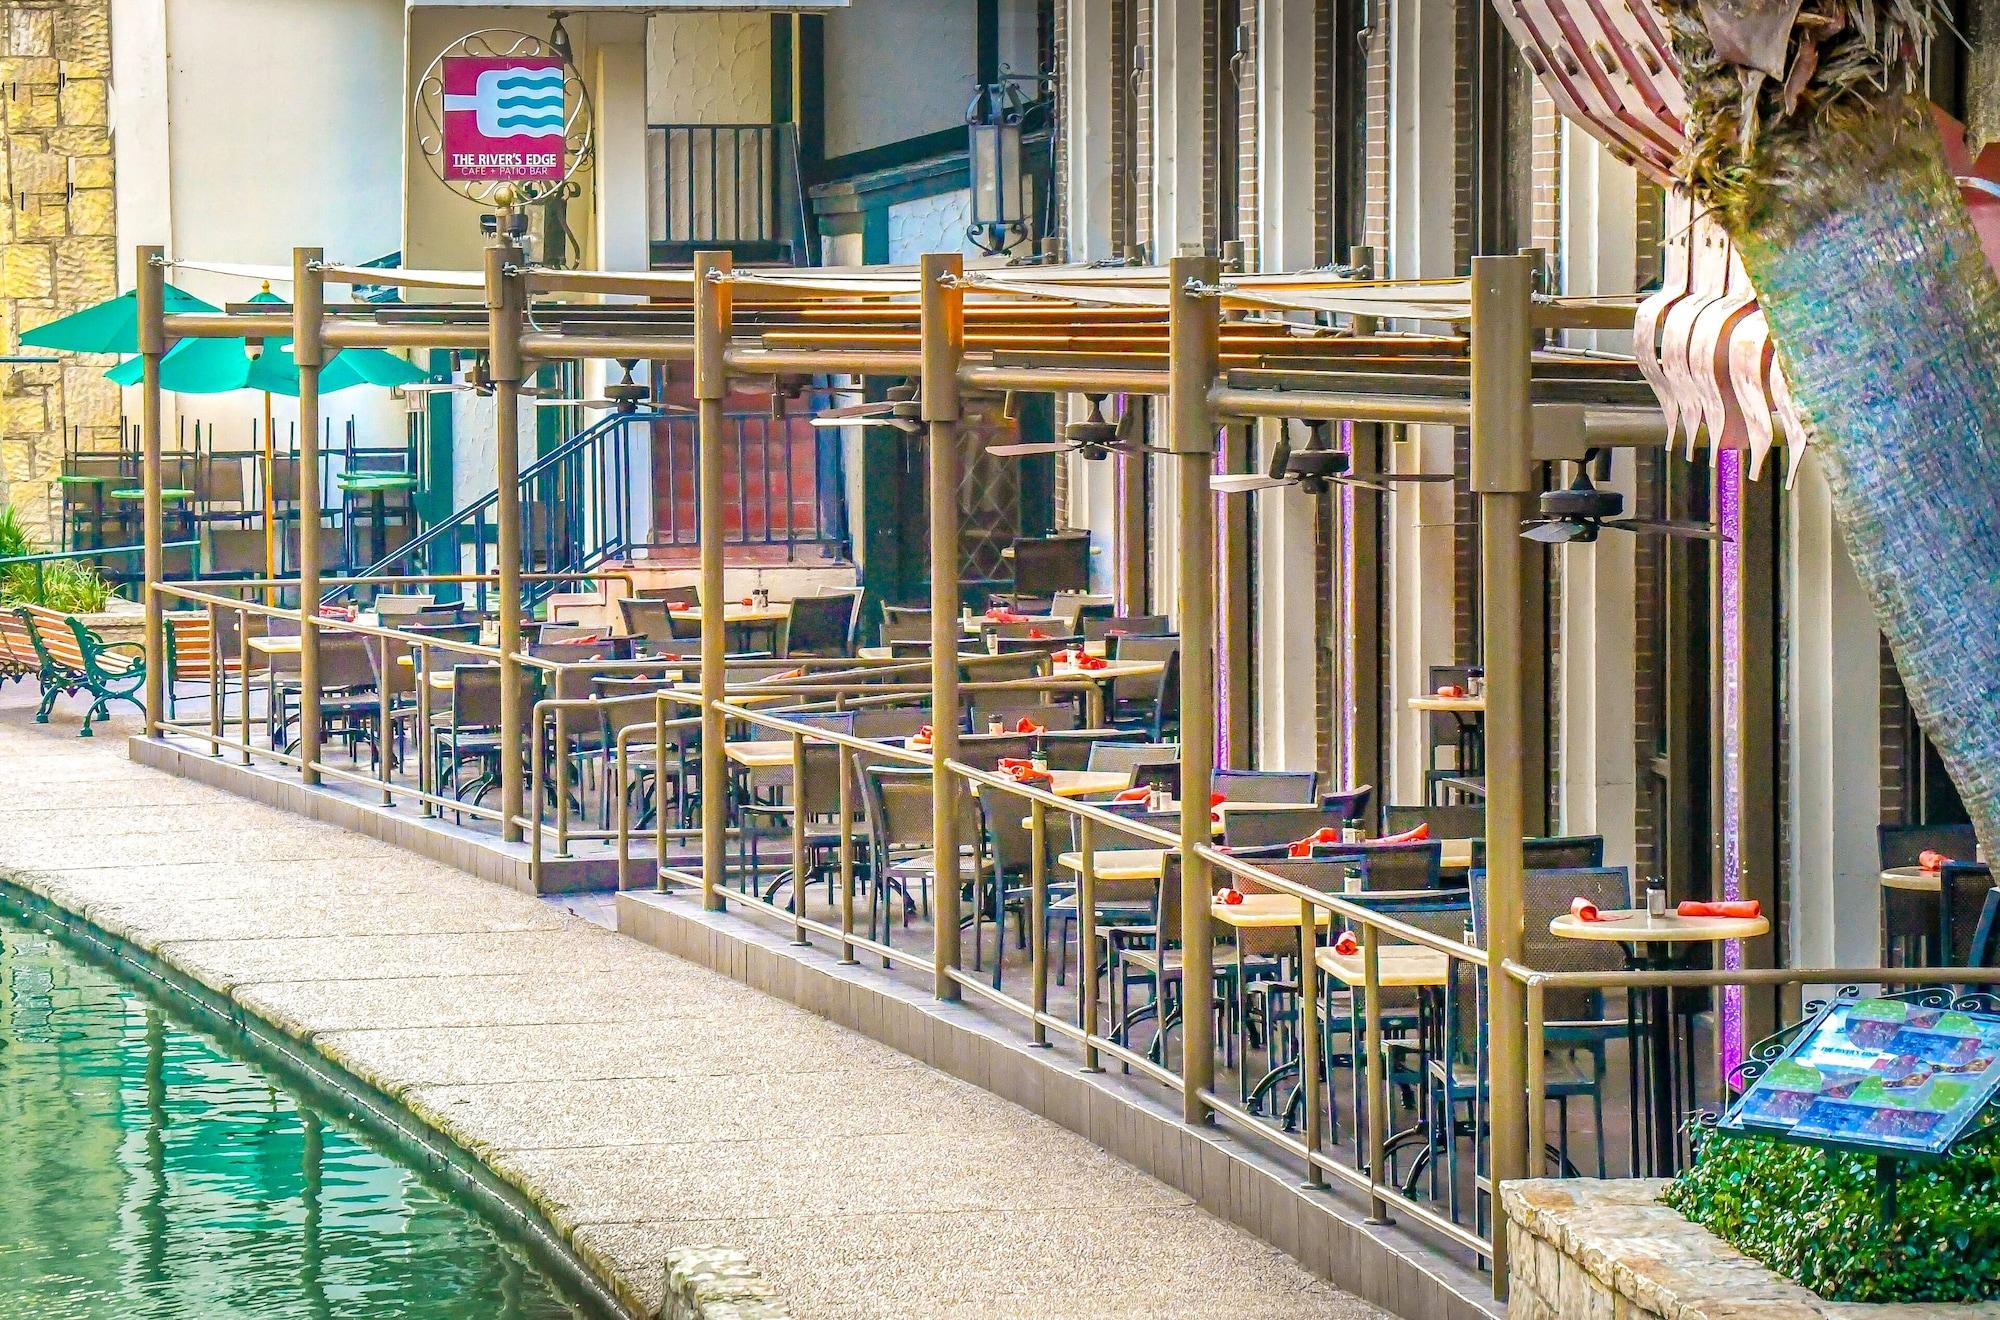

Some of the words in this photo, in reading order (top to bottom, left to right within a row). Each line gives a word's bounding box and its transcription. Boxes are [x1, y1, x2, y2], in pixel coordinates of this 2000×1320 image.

[453, 153, 475, 165] THE
[479, 153, 522, 165] RIVER'S
[526, 153, 557, 165] EDGE
[461, 167, 487, 176] CAFE
[499, 167, 526, 176] PATIO
[529, 167, 548, 176] BAR
